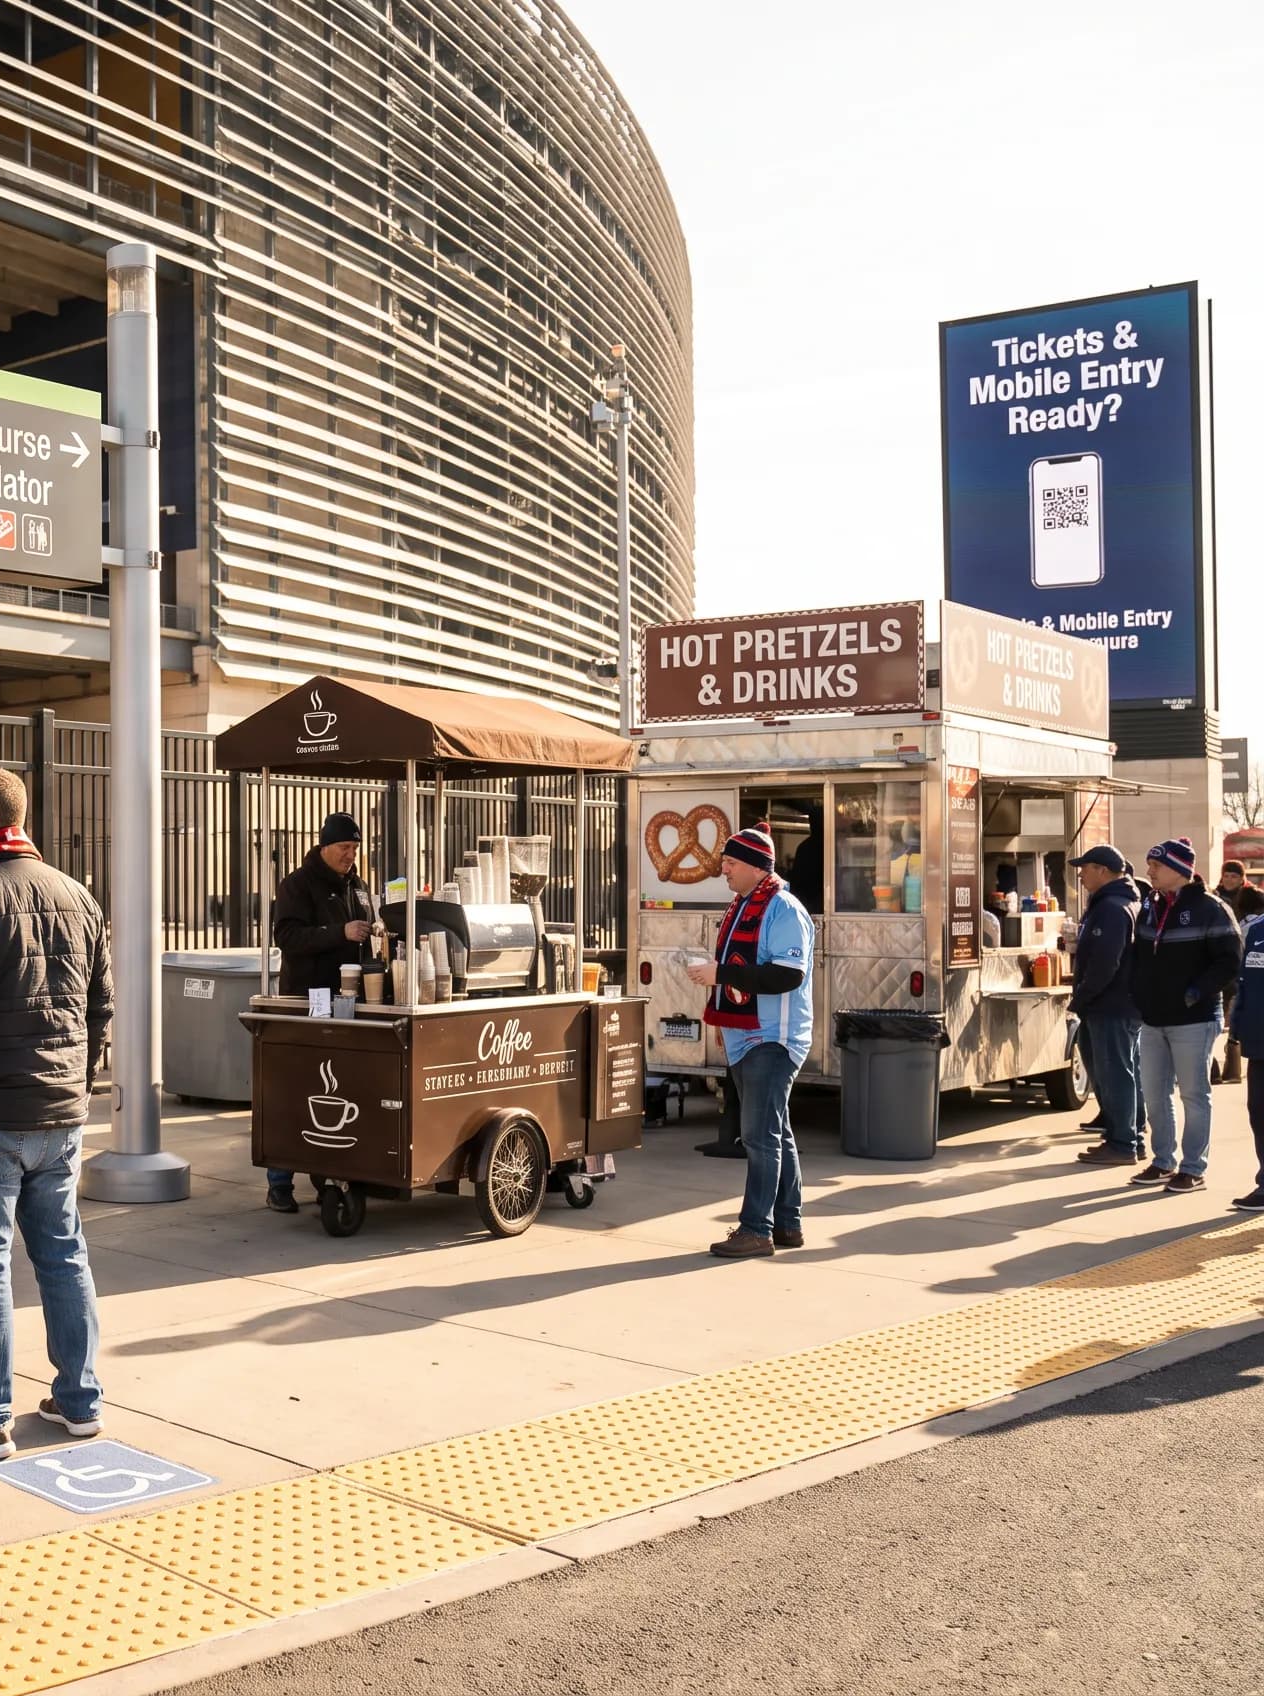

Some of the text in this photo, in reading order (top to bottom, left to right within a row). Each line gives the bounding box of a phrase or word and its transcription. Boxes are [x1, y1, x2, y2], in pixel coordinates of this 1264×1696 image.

[992, 320, 1138, 367] Tickets &
[969, 357, 1165, 406] Mobile Entry
[1008, 393, 1123, 435] Ready?
[660, 618, 902, 669] HOT PRETZELS
[1060, 611, 1118, 632] Mobile
[1124, 609, 1173, 629] Entry
[987, 628, 1074, 681] HOT PRETZELS
[698, 664, 858, 706] & DRINKS
[1003, 672, 1061, 717] & DRINKS
[477, 1018, 533, 1066] Coffee
